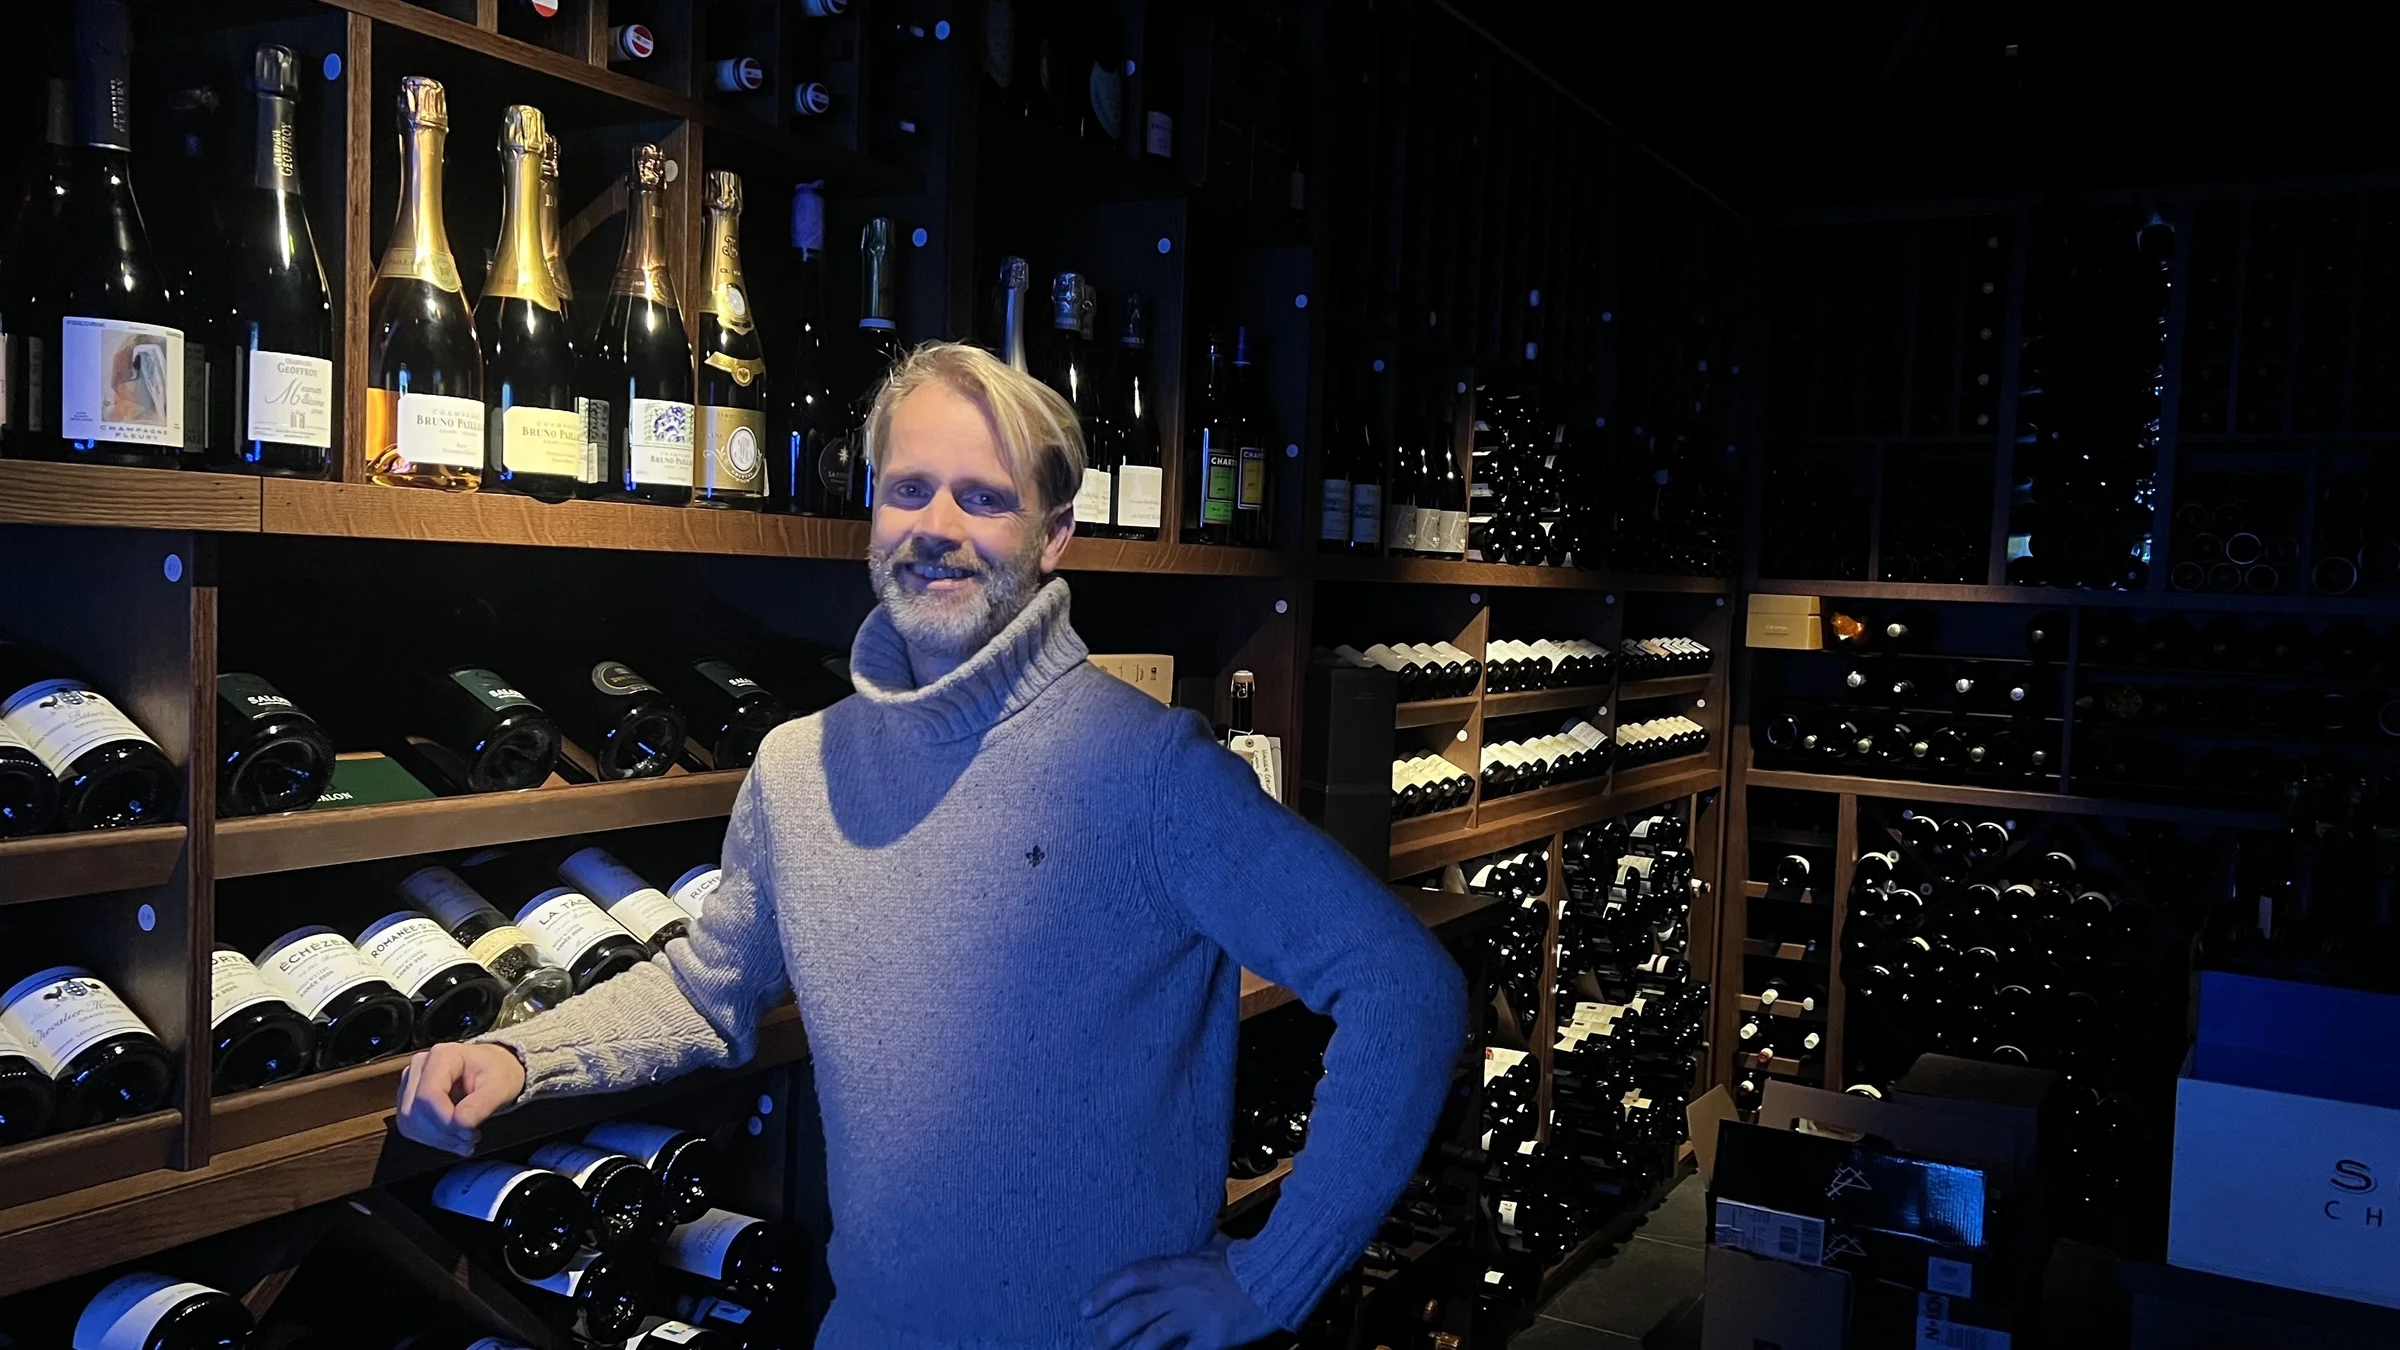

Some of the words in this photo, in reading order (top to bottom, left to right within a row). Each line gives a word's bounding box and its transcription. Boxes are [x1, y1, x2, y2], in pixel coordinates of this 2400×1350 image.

[281, 122, 293, 177] GEOFFROY
[277, 362, 318, 377] GEOFFROY
[416, 414, 454, 427] BRUNO
[99, 424, 168, 436] CHAMPAGNE
[115, 432, 158, 440] FLEURY
[521, 426, 557, 438] BRUNO
[650, 455, 675, 465] BRUNO
[247, 694, 292, 706] SALON
[539, 910, 558, 926] LA
[2329, 1159, 2377, 1194] S
